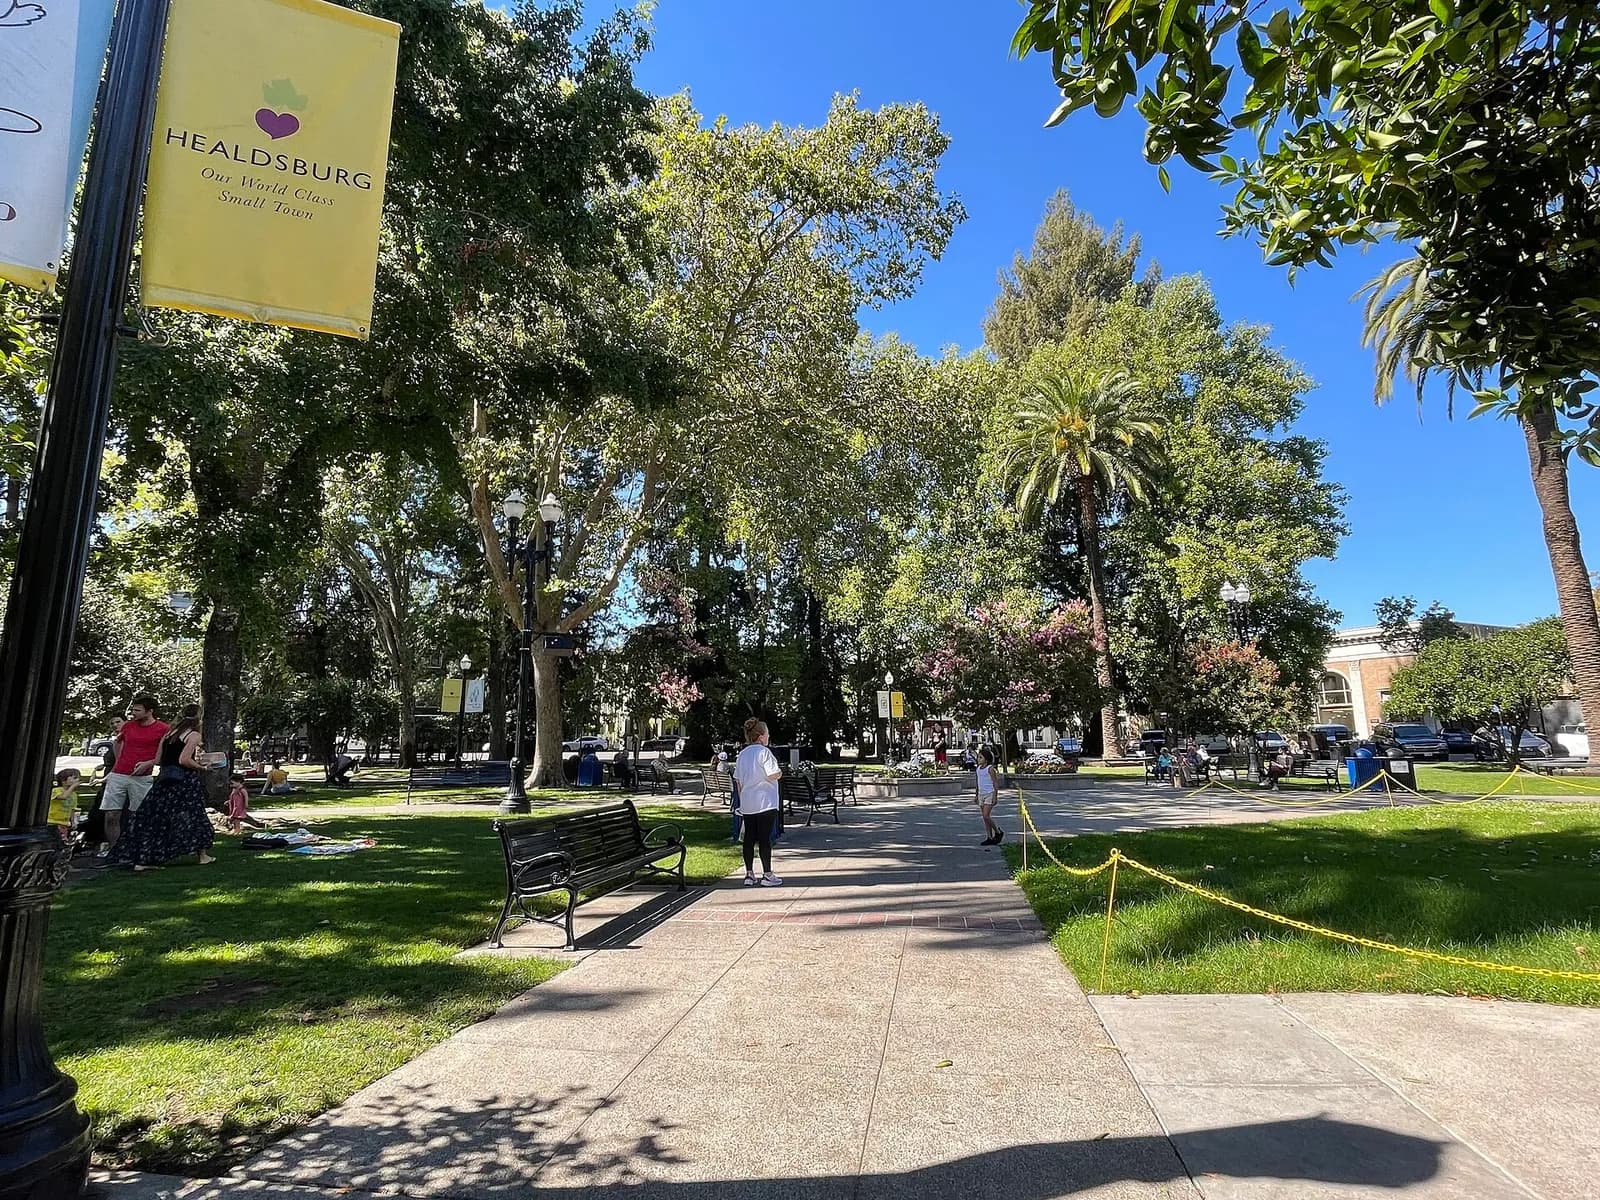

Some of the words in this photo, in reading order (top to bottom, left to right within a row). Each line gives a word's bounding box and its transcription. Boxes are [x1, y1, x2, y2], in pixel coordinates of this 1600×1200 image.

[166, 127, 372, 190] HEALDSBURG
[201, 167, 232, 184] Our
[241, 175, 288, 195] World
[294, 188, 335, 206] Class
[218, 190, 266, 209] Small
[273, 200, 314, 220] Town
